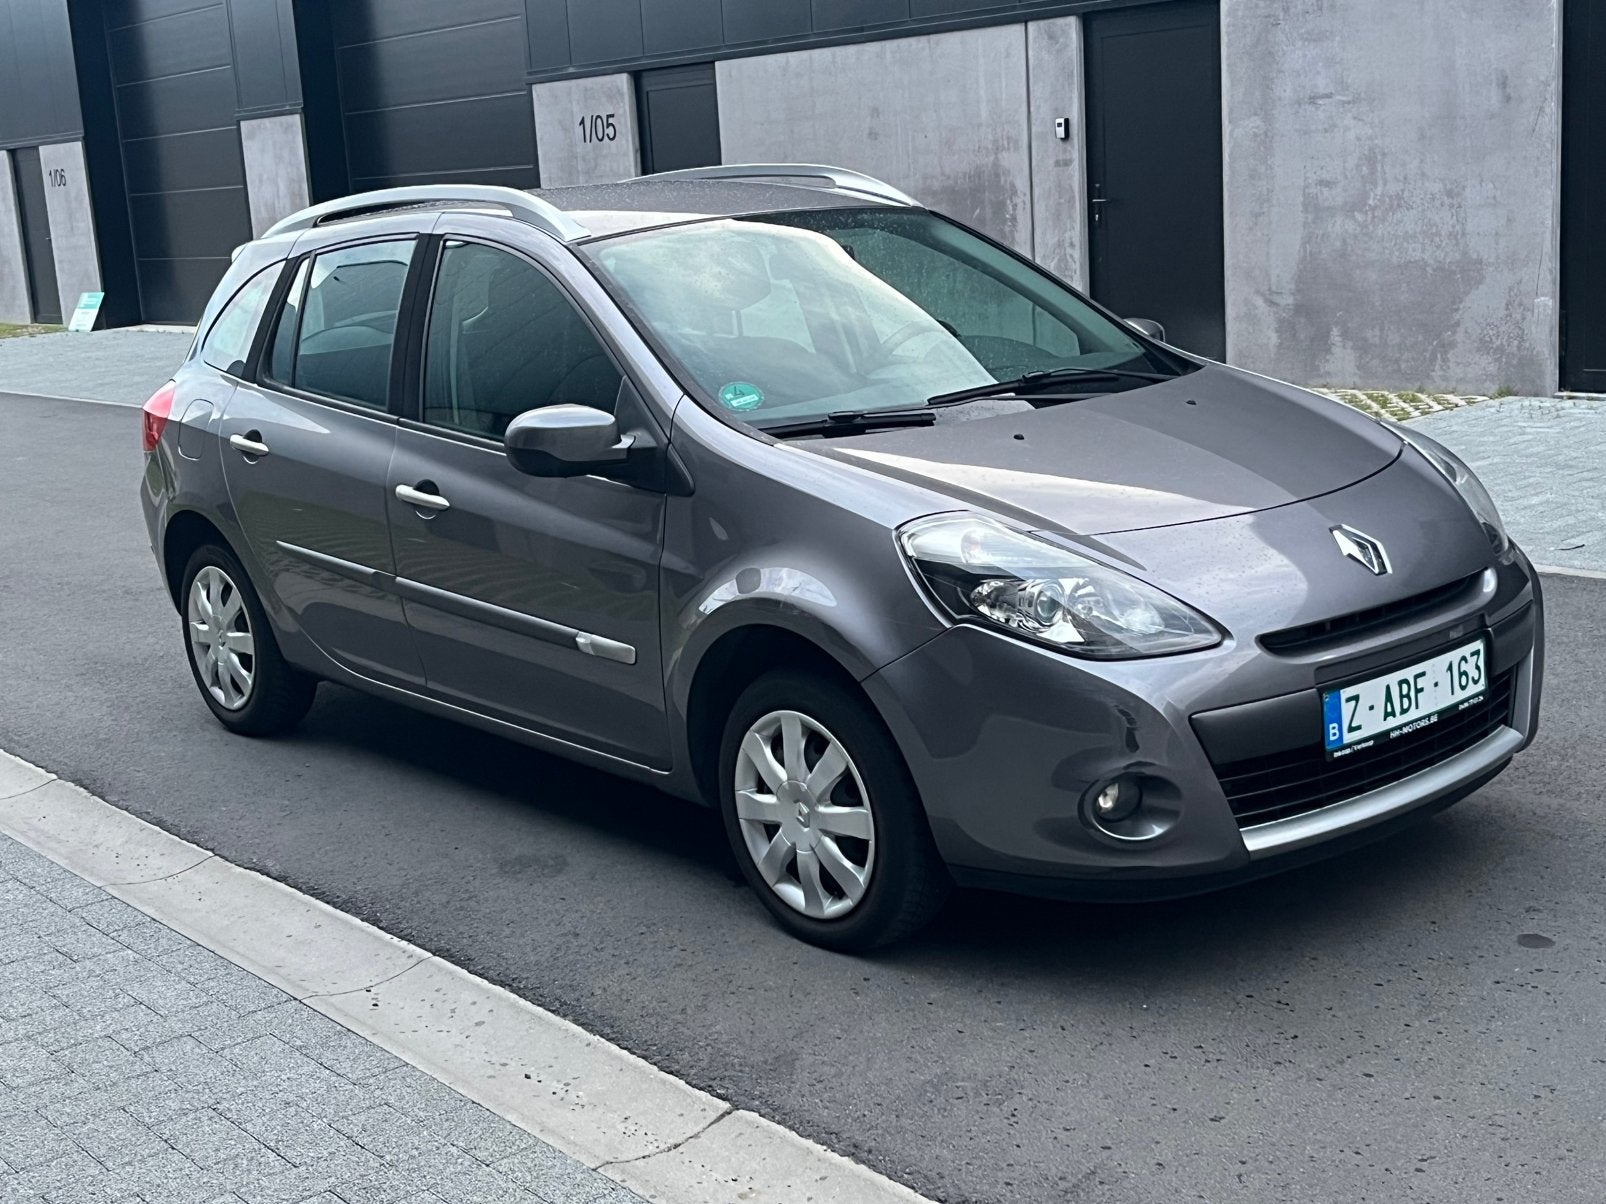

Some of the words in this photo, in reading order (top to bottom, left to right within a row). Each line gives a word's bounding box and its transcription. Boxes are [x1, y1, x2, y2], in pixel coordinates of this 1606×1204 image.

[579, 113, 617, 144] 1/05
[48, 168, 67, 188] 1/06
[1329, 723, 1340, 741] B
